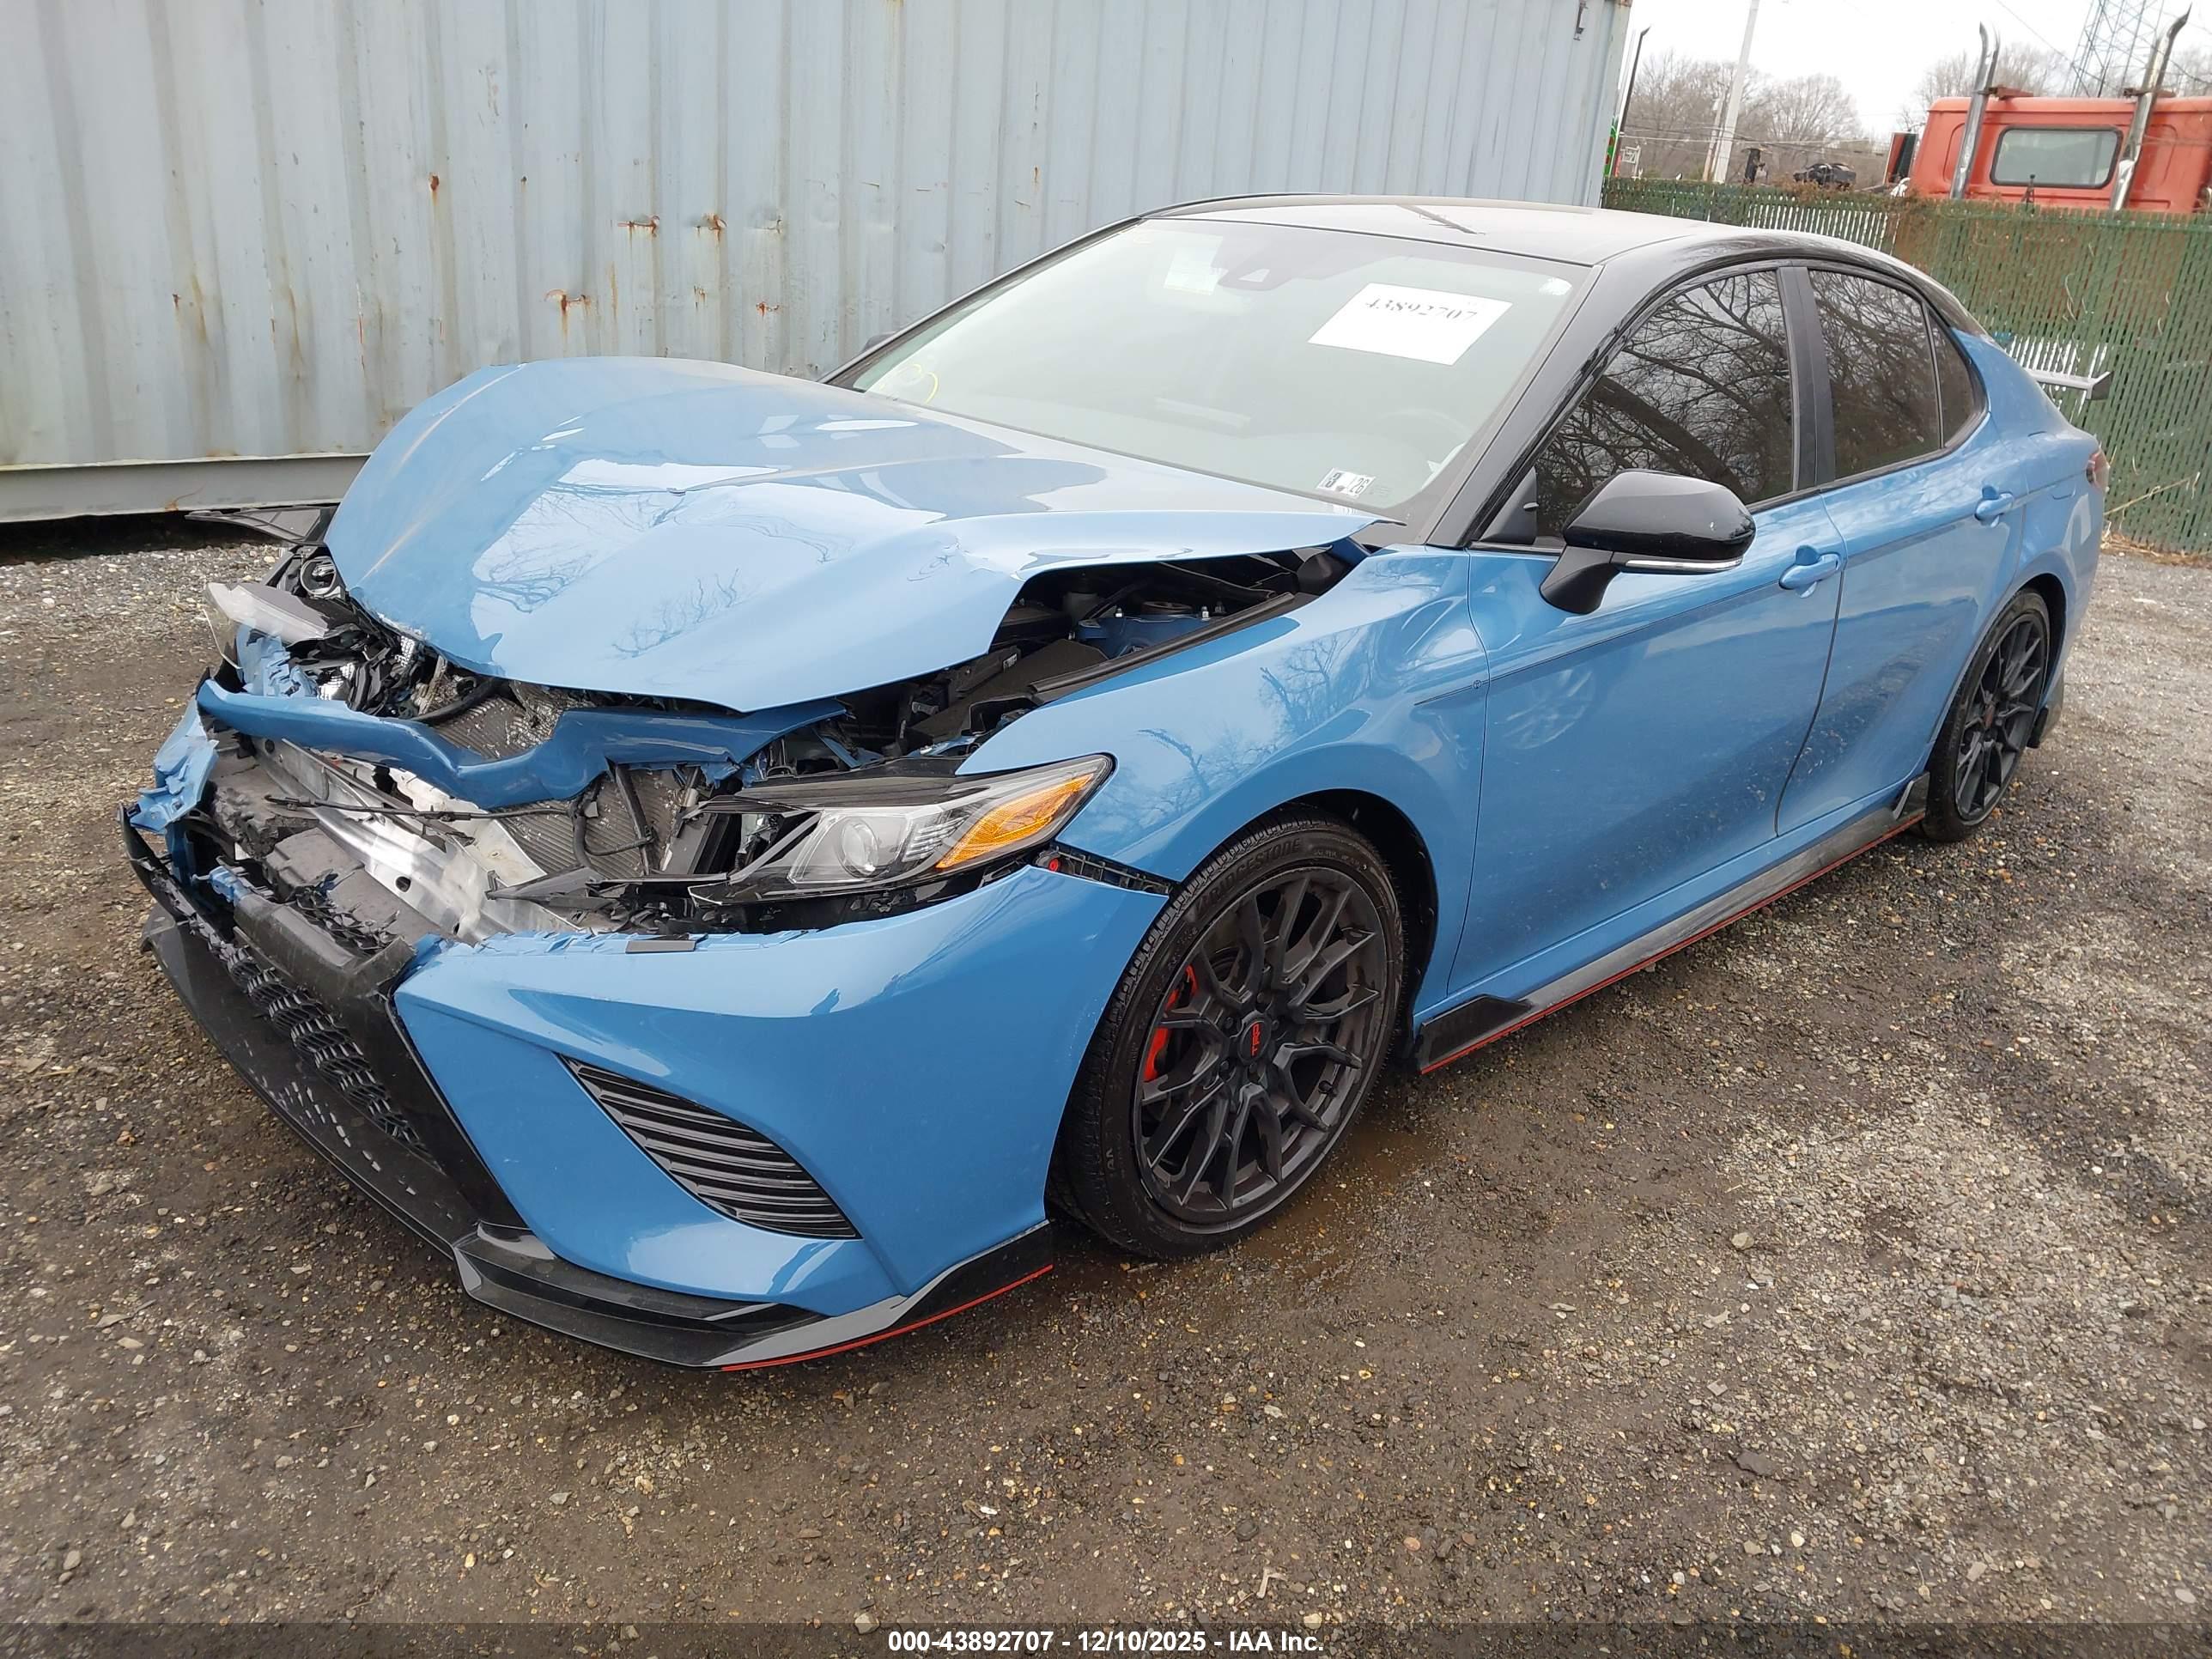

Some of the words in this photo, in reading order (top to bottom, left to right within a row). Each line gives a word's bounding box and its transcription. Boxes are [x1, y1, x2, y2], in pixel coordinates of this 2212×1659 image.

[1365, 298, 1478, 321] 43892707
[1350, 477, 1369, 494] 26
[1250, 1023, 1261, 1057] TRD
